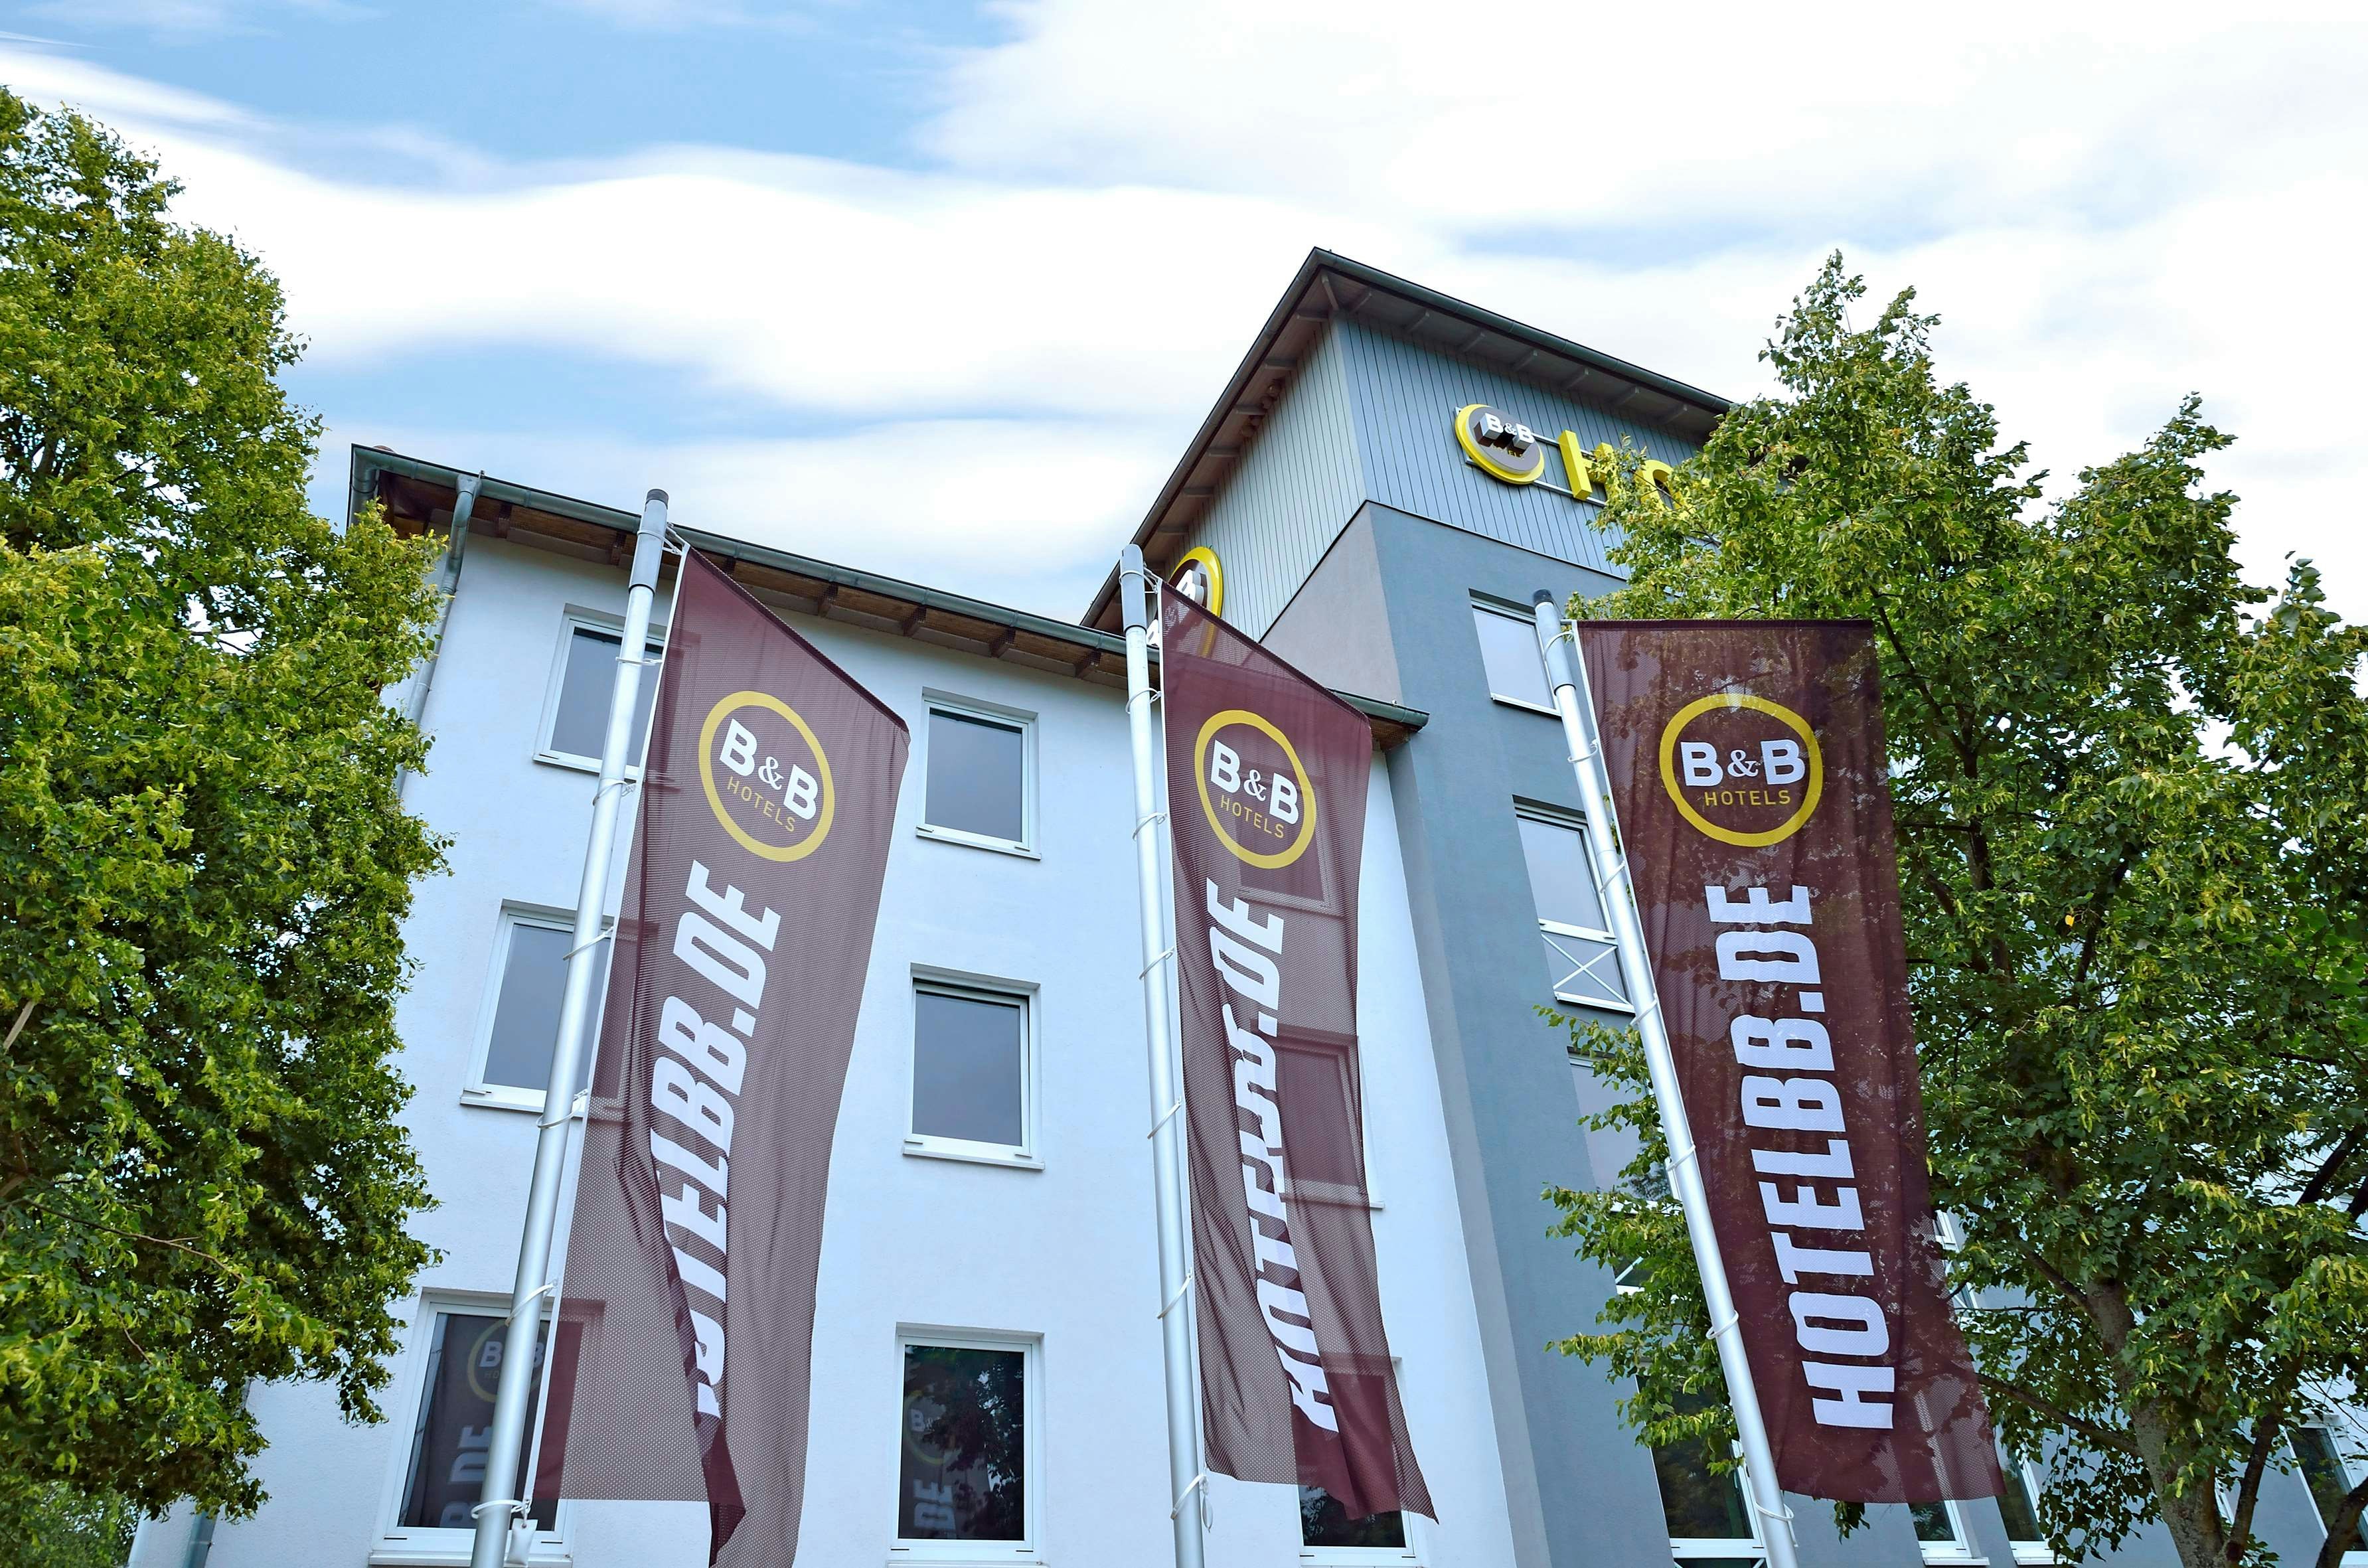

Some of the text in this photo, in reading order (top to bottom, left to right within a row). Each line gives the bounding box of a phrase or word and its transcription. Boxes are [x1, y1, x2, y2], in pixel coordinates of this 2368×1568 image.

[1480, 412, 1535, 449] B&B
[719, 718, 819, 821] B&B
[1210, 739, 1299, 824] B&B
[1680, 739, 1806, 787] B&B
[727, 776, 796, 832] HOTELS
[1220, 794, 1285, 838] HOTELS
[1704, 789, 1792, 807] HOTELS
[1704, 884, 1895, 1429] HOTELBB.DE
